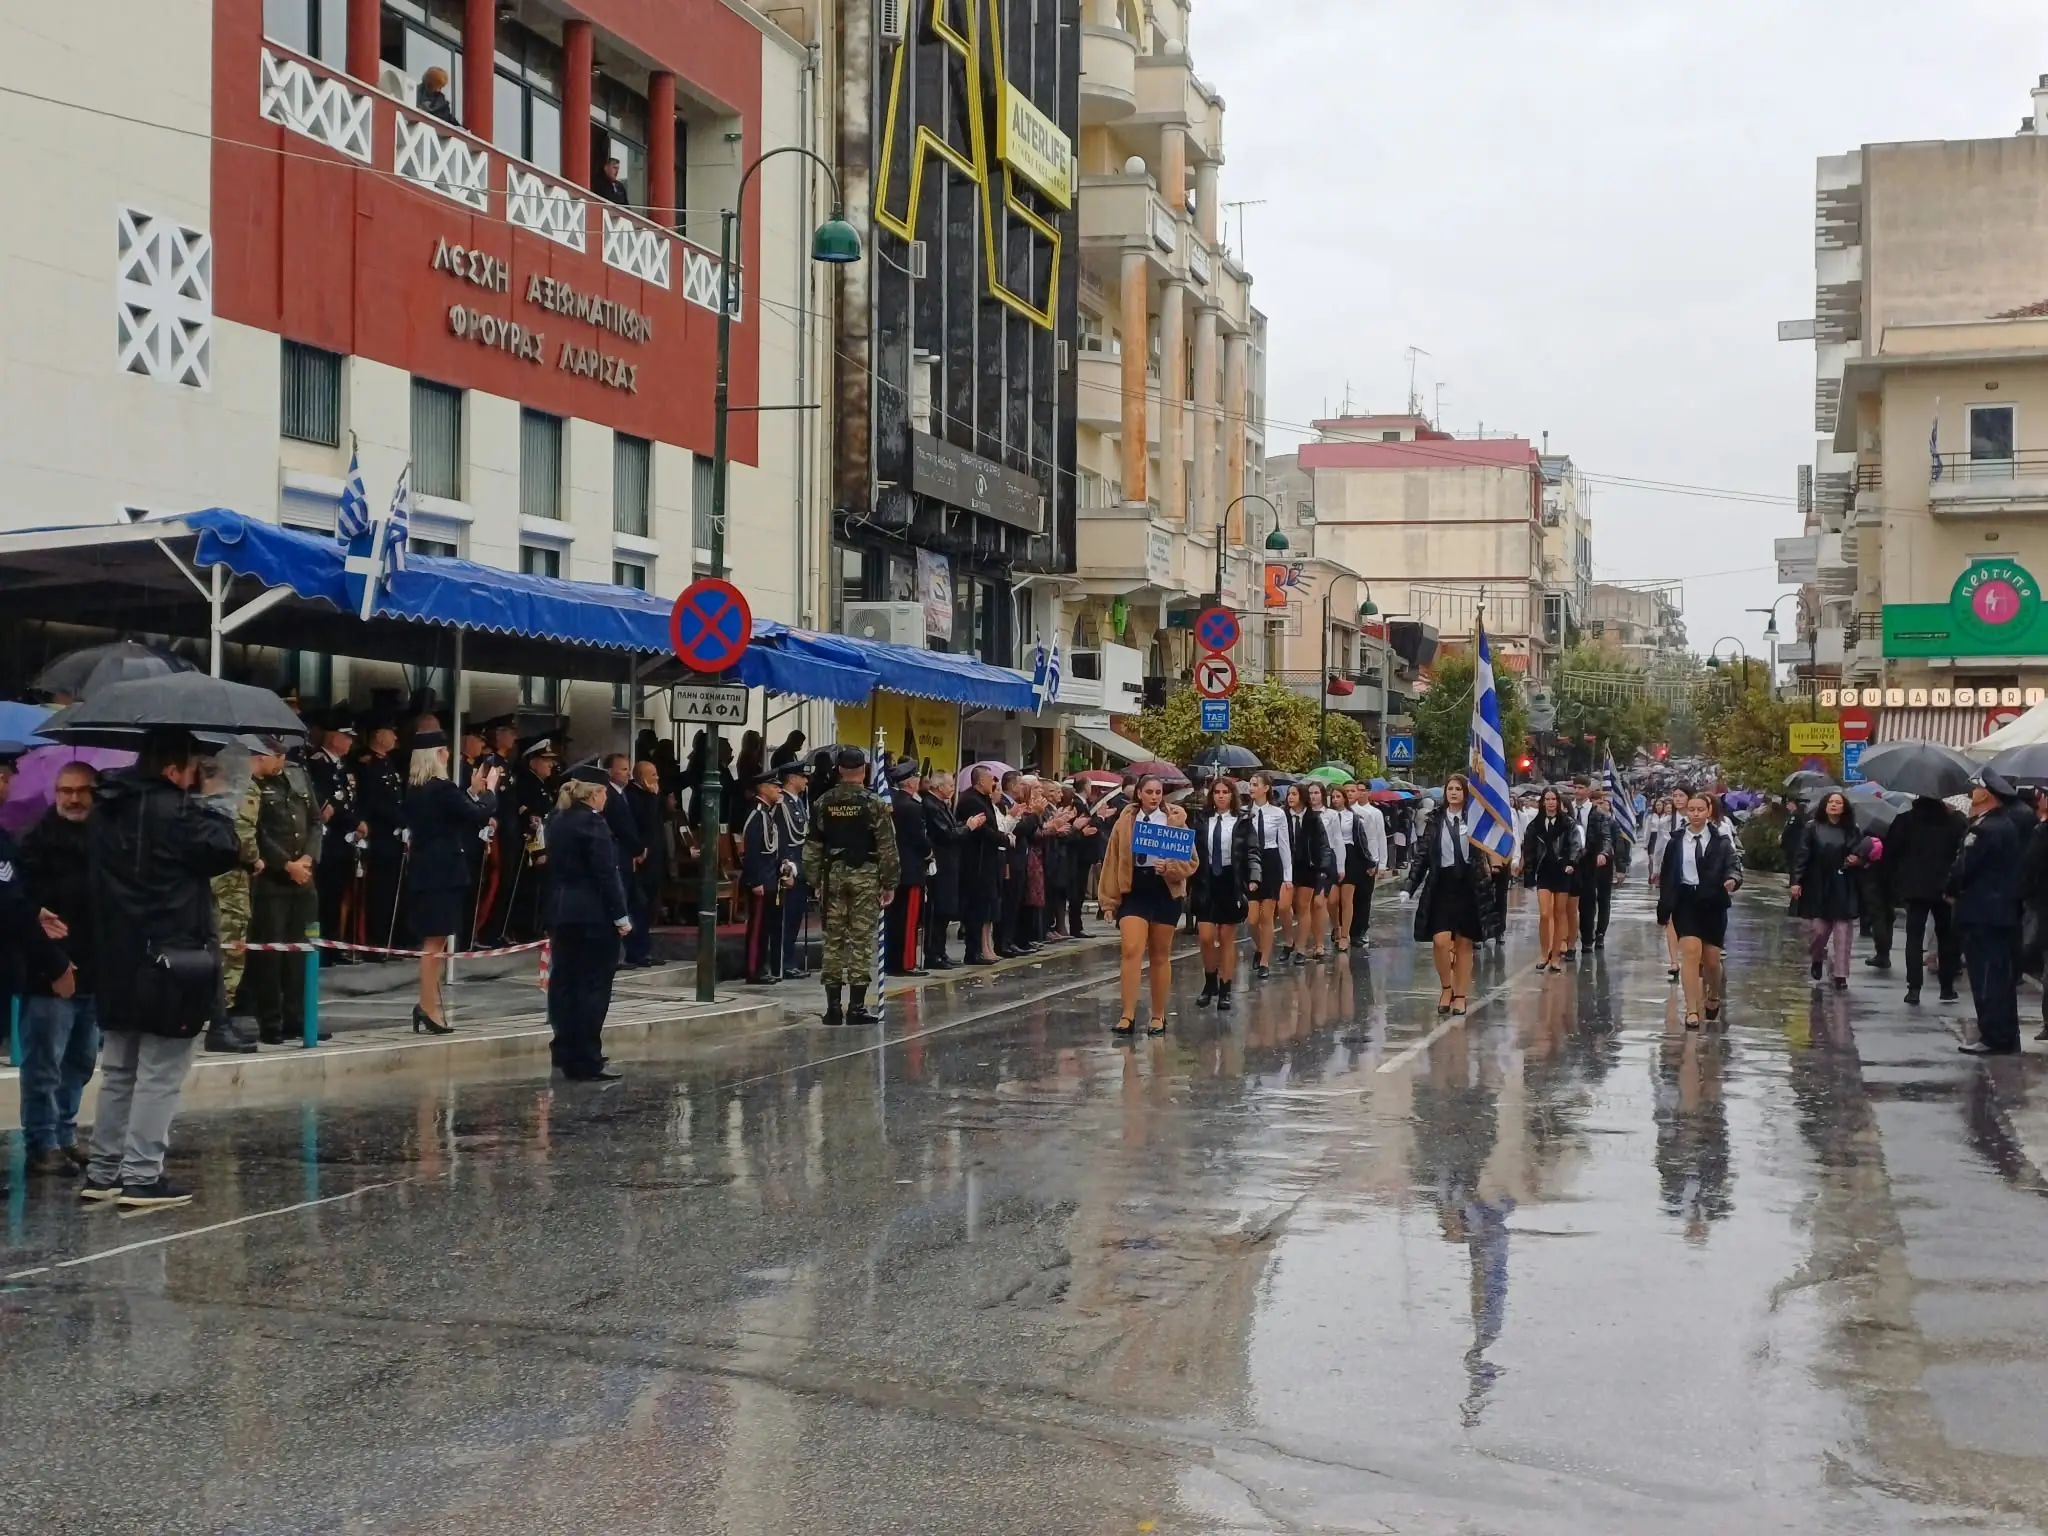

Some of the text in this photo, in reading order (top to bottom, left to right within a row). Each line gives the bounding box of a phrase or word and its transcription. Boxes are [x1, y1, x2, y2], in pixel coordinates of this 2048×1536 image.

[1012, 101, 1066, 175] ALTERLIFE
[432, 235, 652, 345] ΛΕΣΧΗ ΑΞΙΩΜΑΤΙΚΩΝ
[450, 303, 638, 394] ΦΡΟΥΡΑΣ ΛΑΡΙΣΑΣ
[677, 691, 741, 702] ΠΛΗΝ ΟΧΗΜΑΤΩΝ
[1825, 691, 2038, 705] BOULANGERI
[1205, 713, 1226, 721] ΤΑΞΙ
[1157, 828, 1190, 841] ΕΝΙΑΙΟ
[1134, 837, 1191, 854] ΛΥΚΕΙΟ ΛΑΡΙΣΑΣ
